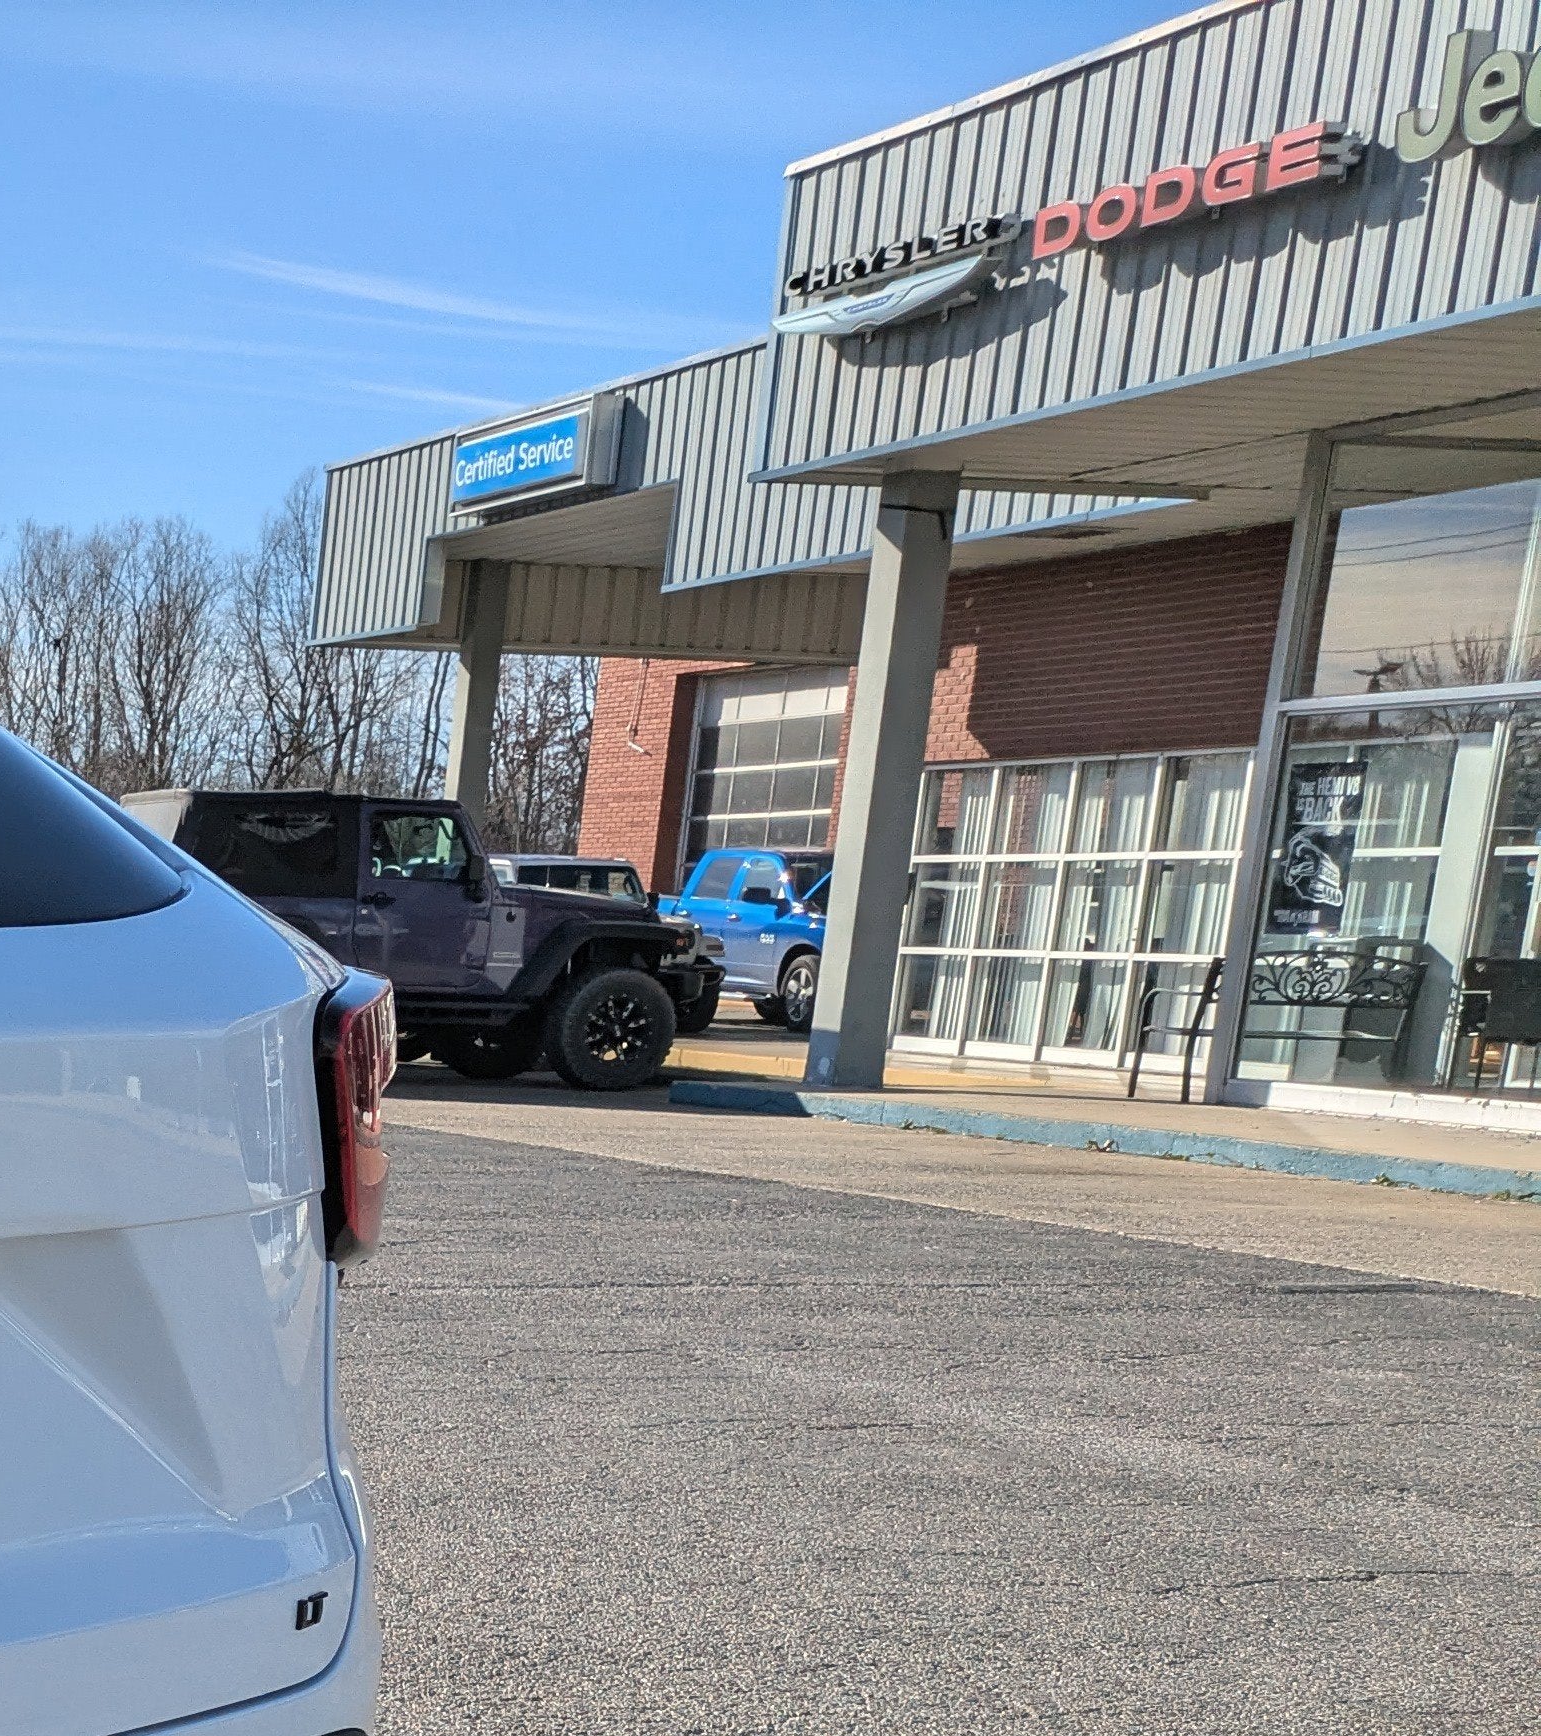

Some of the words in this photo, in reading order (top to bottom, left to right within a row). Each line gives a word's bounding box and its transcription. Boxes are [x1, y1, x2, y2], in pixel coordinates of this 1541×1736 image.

[1032, 120, 1326, 260] DODGE
[784, 216, 989, 297] CHRYSLER
[455, 449, 516, 487] Certified
[518, 433, 574, 470] Service
[1301, 796, 1344, 821] BACK
[295, 1591, 328, 1630] LT
